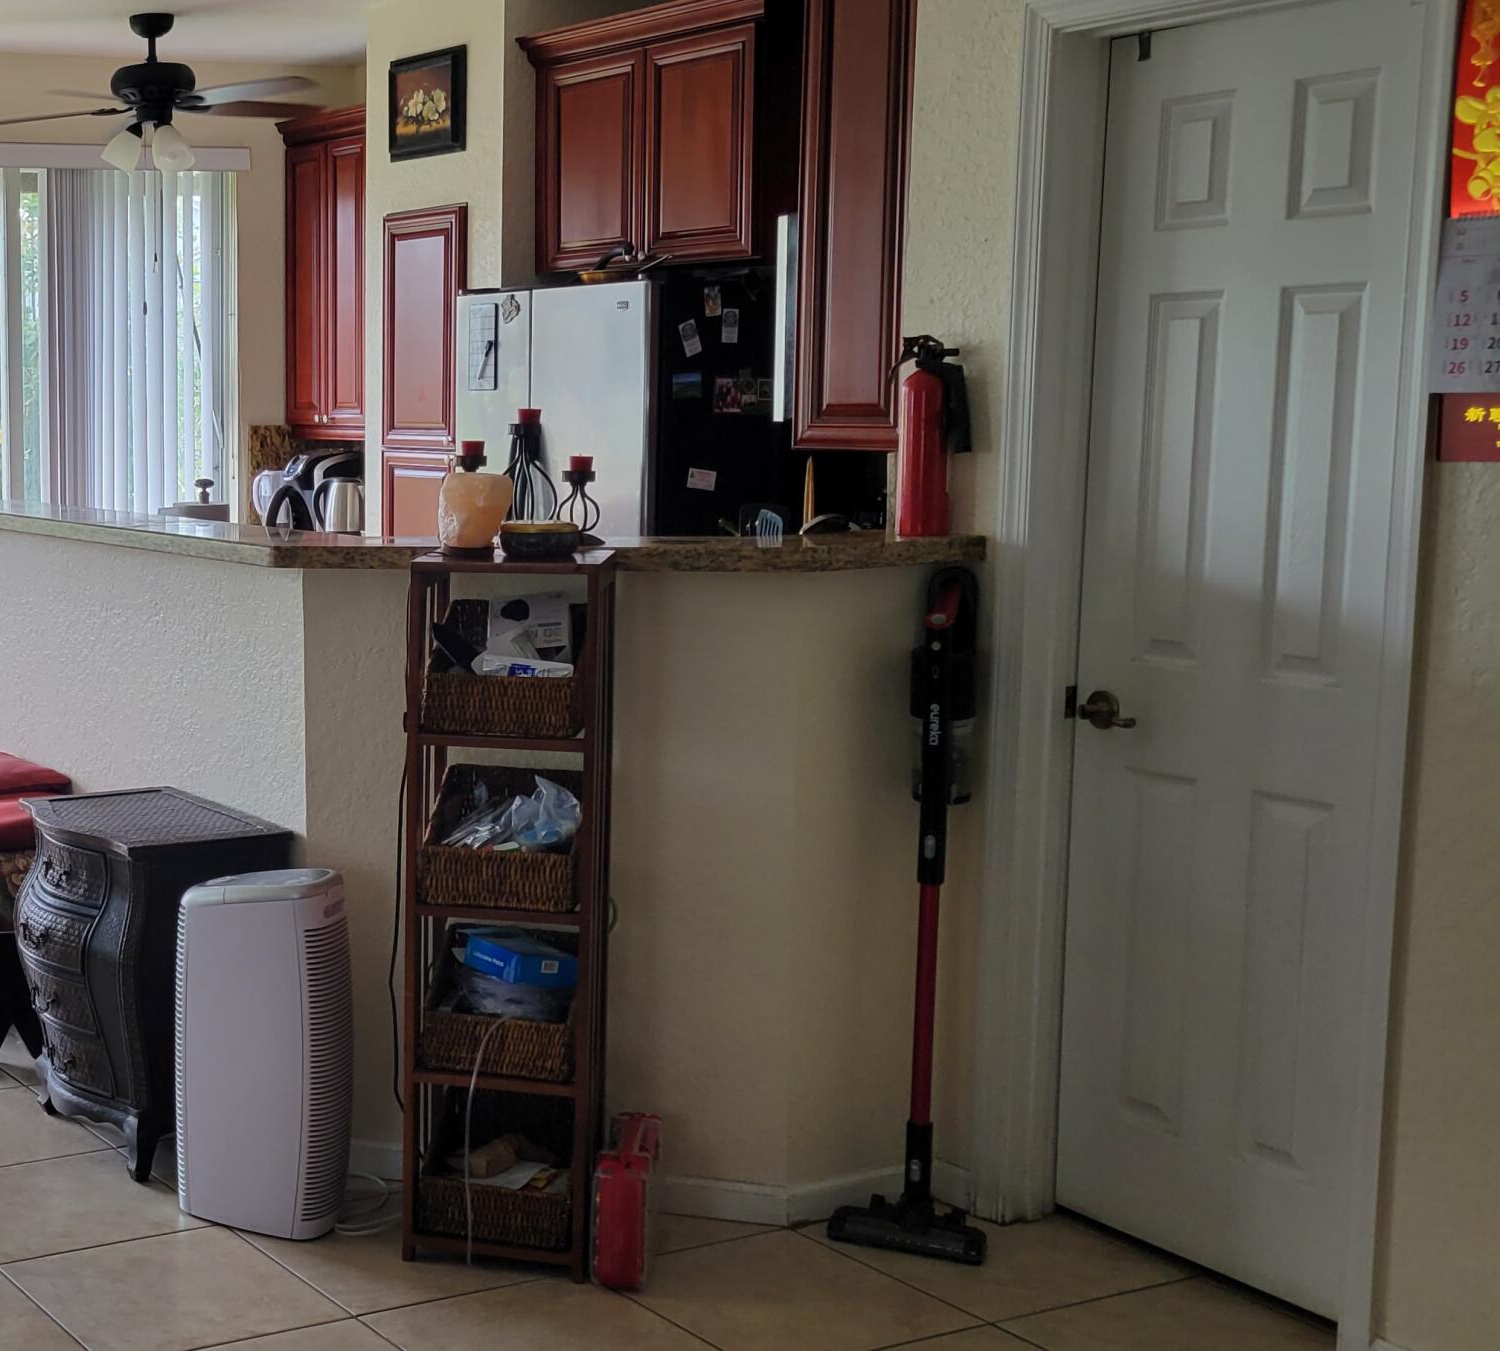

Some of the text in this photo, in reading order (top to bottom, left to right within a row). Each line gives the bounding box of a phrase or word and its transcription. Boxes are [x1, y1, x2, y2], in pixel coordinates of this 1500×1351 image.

[1460, 290, 1469, 303] 5
[1453, 313, 1471, 327] 12
[1451, 338, 1469, 351] 19
[1448, 361, 1466, 374] 26
[930, 704, 941, 745] eureka
